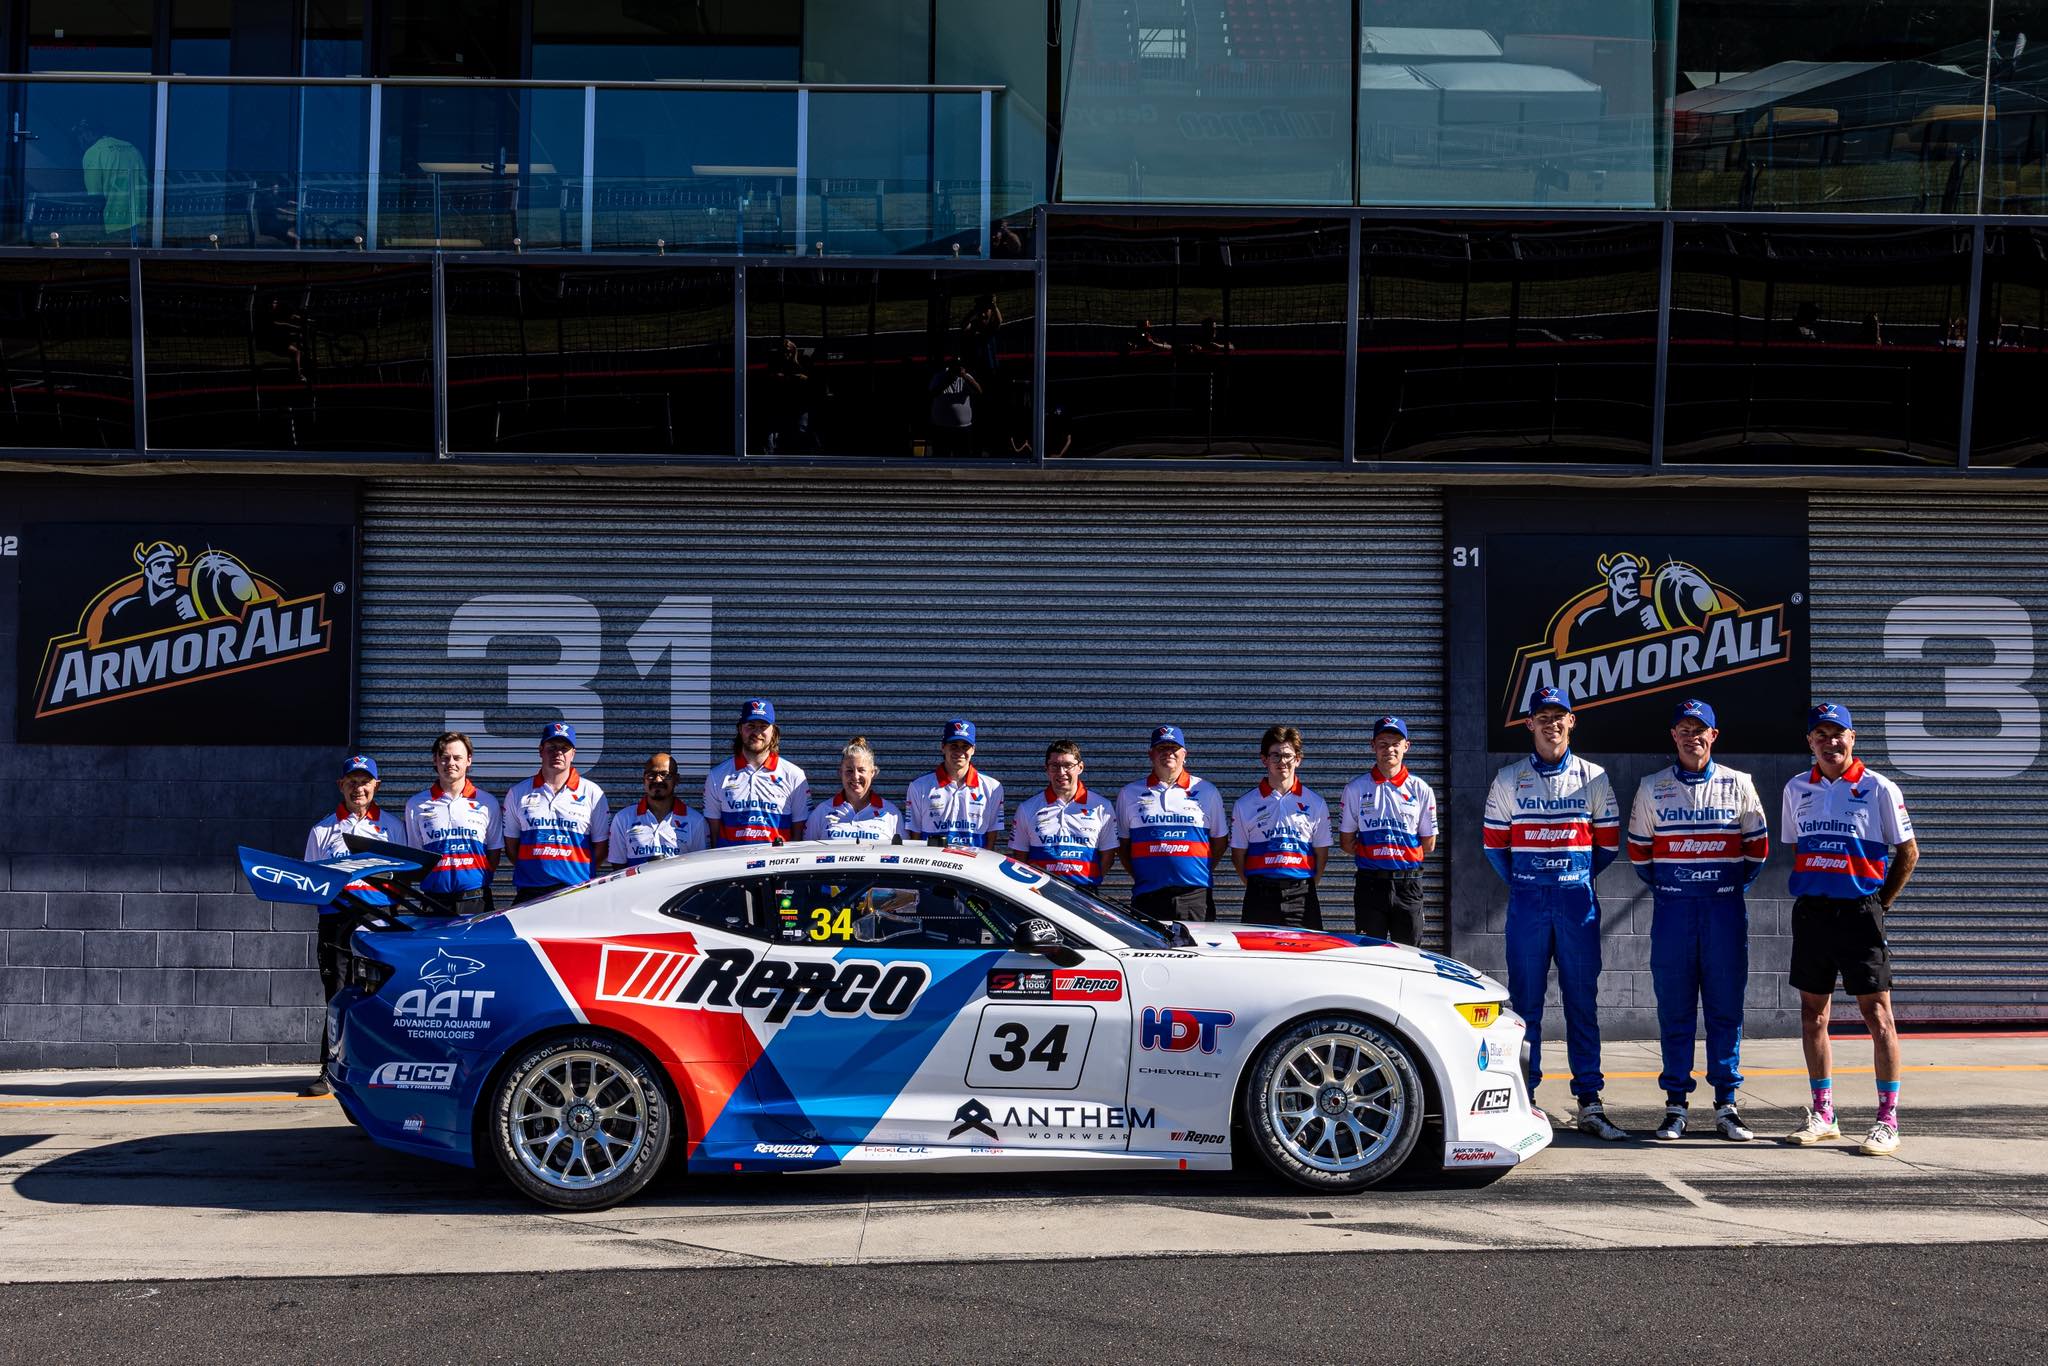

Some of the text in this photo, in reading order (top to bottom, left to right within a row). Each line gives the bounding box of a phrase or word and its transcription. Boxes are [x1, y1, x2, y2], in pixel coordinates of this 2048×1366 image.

[0, 536, 18, 556] 2
[1453, 547, 1480, 567] 31
[445, 594, 712, 777] 31
[1884, 595, 2041, 778] 3
[728, 799, 778, 811] Valvoline
[1517, 797, 1586, 809] Valvoline
[1141, 813, 1195, 824] Valvoline
[1656, 807, 1736, 821] Valvoline
[526, 817, 578, 829] Valvoline
[934, 819, 976, 830] Valvoline
[1799, 820, 1857, 833] Valvoline
[426, 826, 478, 840] Valvoline
[827, 829, 880, 840] Valvoline
[1039, 834, 1090, 845] Valvoline
[1163, 830, 1187, 838] AAT
[1539, 828, 1577, 842] Repco
[632, 844, 680, 856] Valvoline
[1159, 843, 1190, 854] Repco
[1681, 839, 1727, 854] Repco
[1818, 841, 1847, 850] AAT
[769, 857, 800, 866] MOFFAT
[902, 856, 964, 870] GARRY ROGERS
[1546, 858, 1571, 868] AAT
[1811, 856, 1848, 869] Repco
[251, 865, 330, 896] GRM
[1691, 870, 1721, 880] AAT
[809, 907, 853, 941] 34
[675, 947, 927, 1024] Repco
[1073, 976, 1118, 993] Repco
[393, 989, 496, 1018] AAT
[393, 1019, 491, 1029] ADVANCED AQUARIUM
[1141, 1006, 1235, 1054] HDT
[407, 1030, 475, 1040] TECHNOLOGIES
[989, 1022, 1070, 1072] 34
[1333, 1021, 1408, 1071] DUNLOP
[394, 1065, 450, 1082] HCC
[1139, 1067, 1222, 1078] CHEVROLET
[1482, 1090, 1510, 1108] HCC
[1003, 1107, 1156, 1129] ANTHEM
[630, 1089, 660, 1174] DUNLOP
[1028, 1132, 1130, 1141] WORKWEAR
[1184, 1130, 1226, 1145] Repco
[753, 1143, 821, 1154] REVOLUTION
[1453, 1151, 1497, 1161] MOUNTAIN
